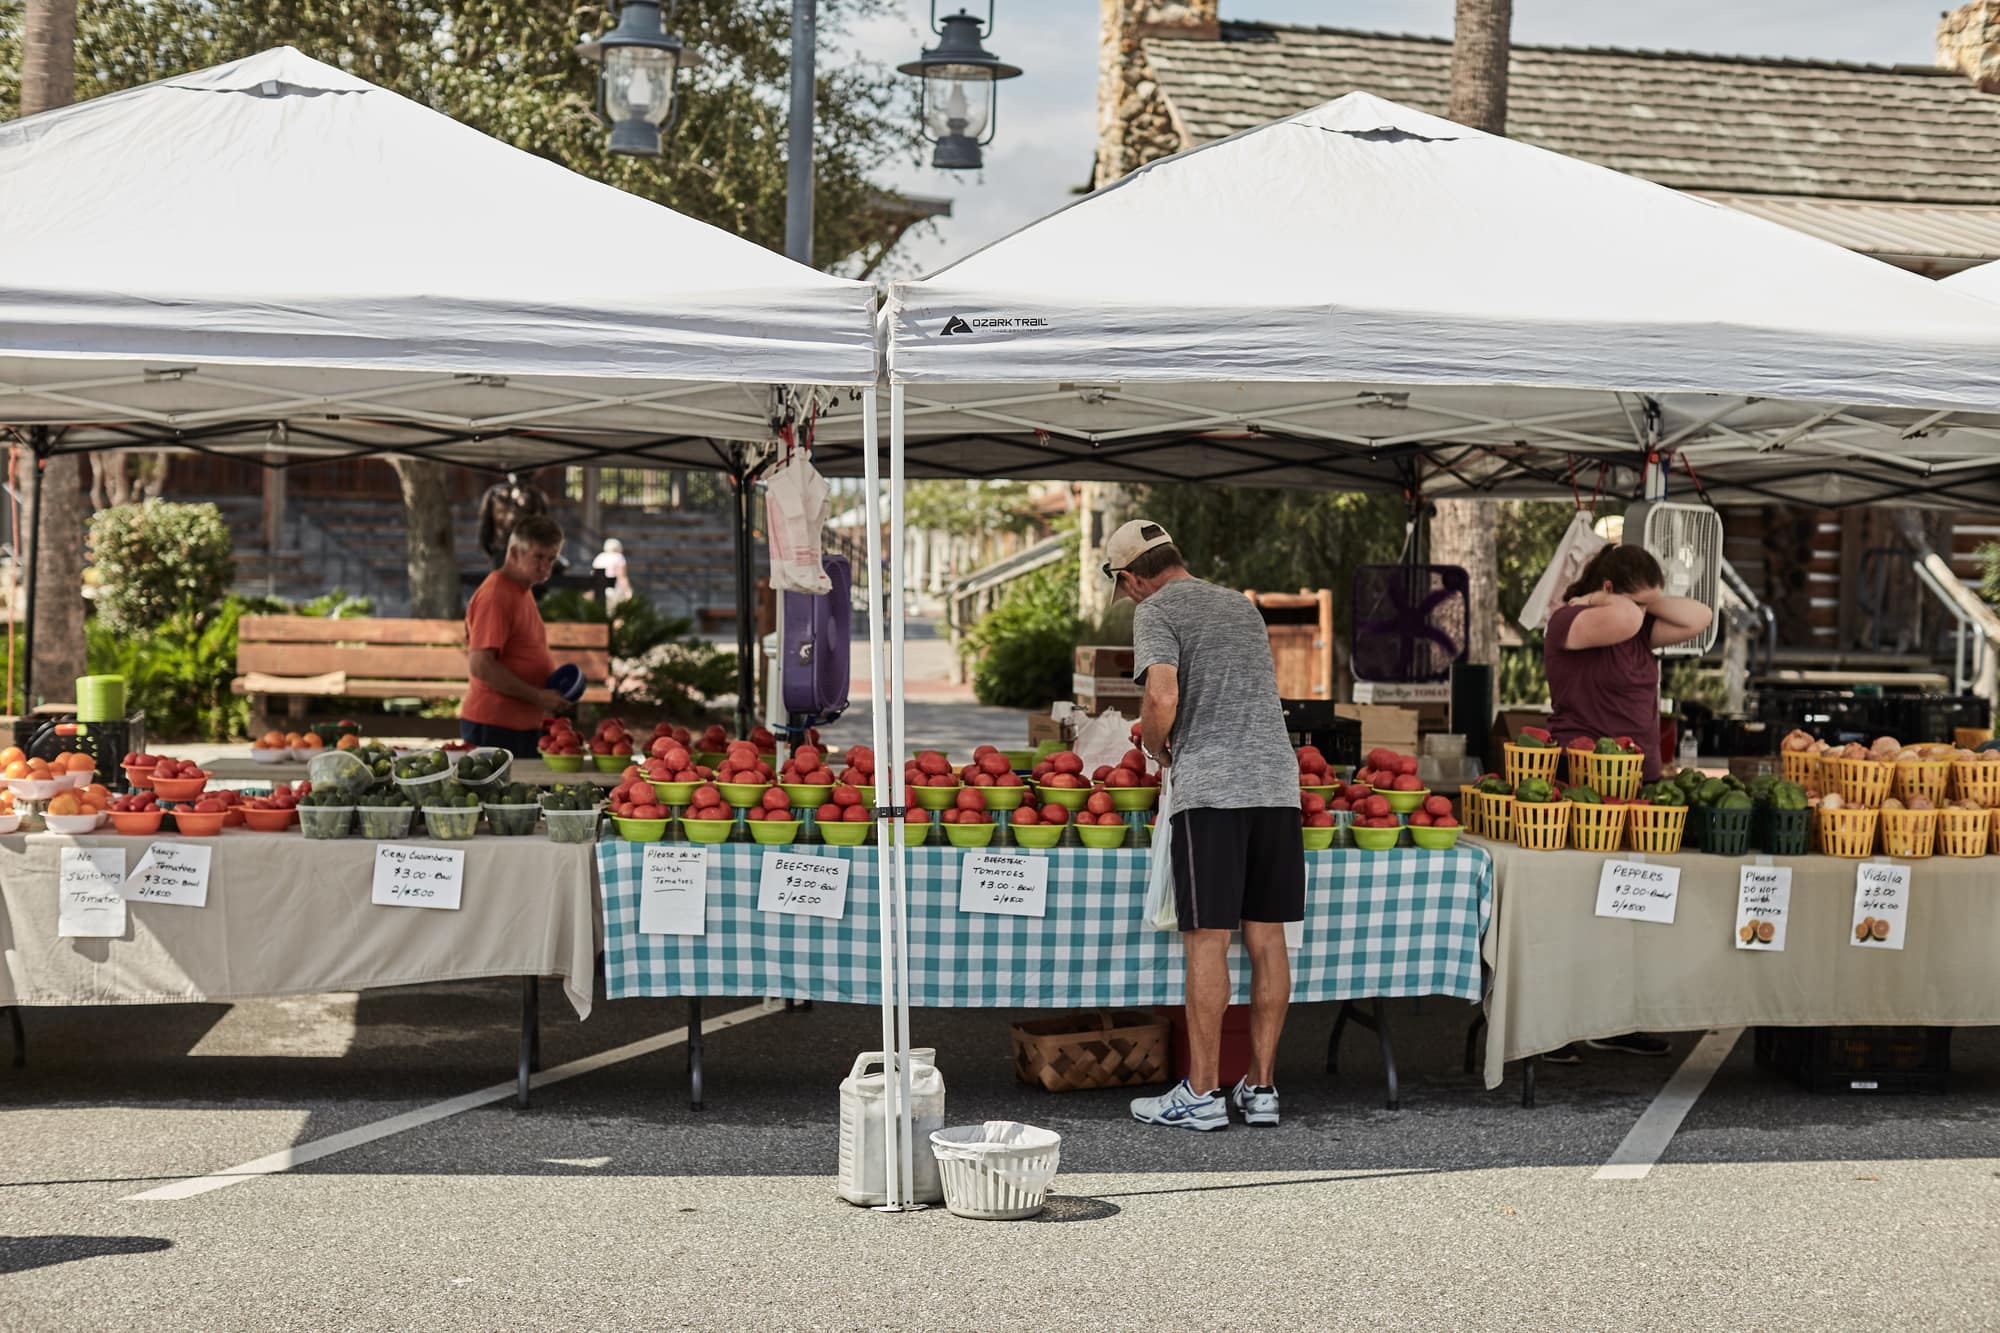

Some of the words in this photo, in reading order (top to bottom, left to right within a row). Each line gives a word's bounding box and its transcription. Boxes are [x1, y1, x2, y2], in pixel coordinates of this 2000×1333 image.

[972, 318, 1012, 327] OZARK
[1014, 317, 1049, 327] TRAIL
[76, 850, 93, 862] No
[647, 849, 675, 860] Please
[775, 859, 840, 876] BEEFSTEAKS
[972, 867, 1025, 878] TOMATOES
[1613, 864, 1664, 882] PEPPERS
[66, 870, 121, 886] Switching
[652, 876, 694, 885] Tomatoes
[1745, 871, 1777, 882] Please
[1863, 868, 1903, 885] Vidalia
[1744, 886, 1756, 894] DO
[1760, 886, 1778, 895] NOT
[1745, 906, 1782, 917] peppers
